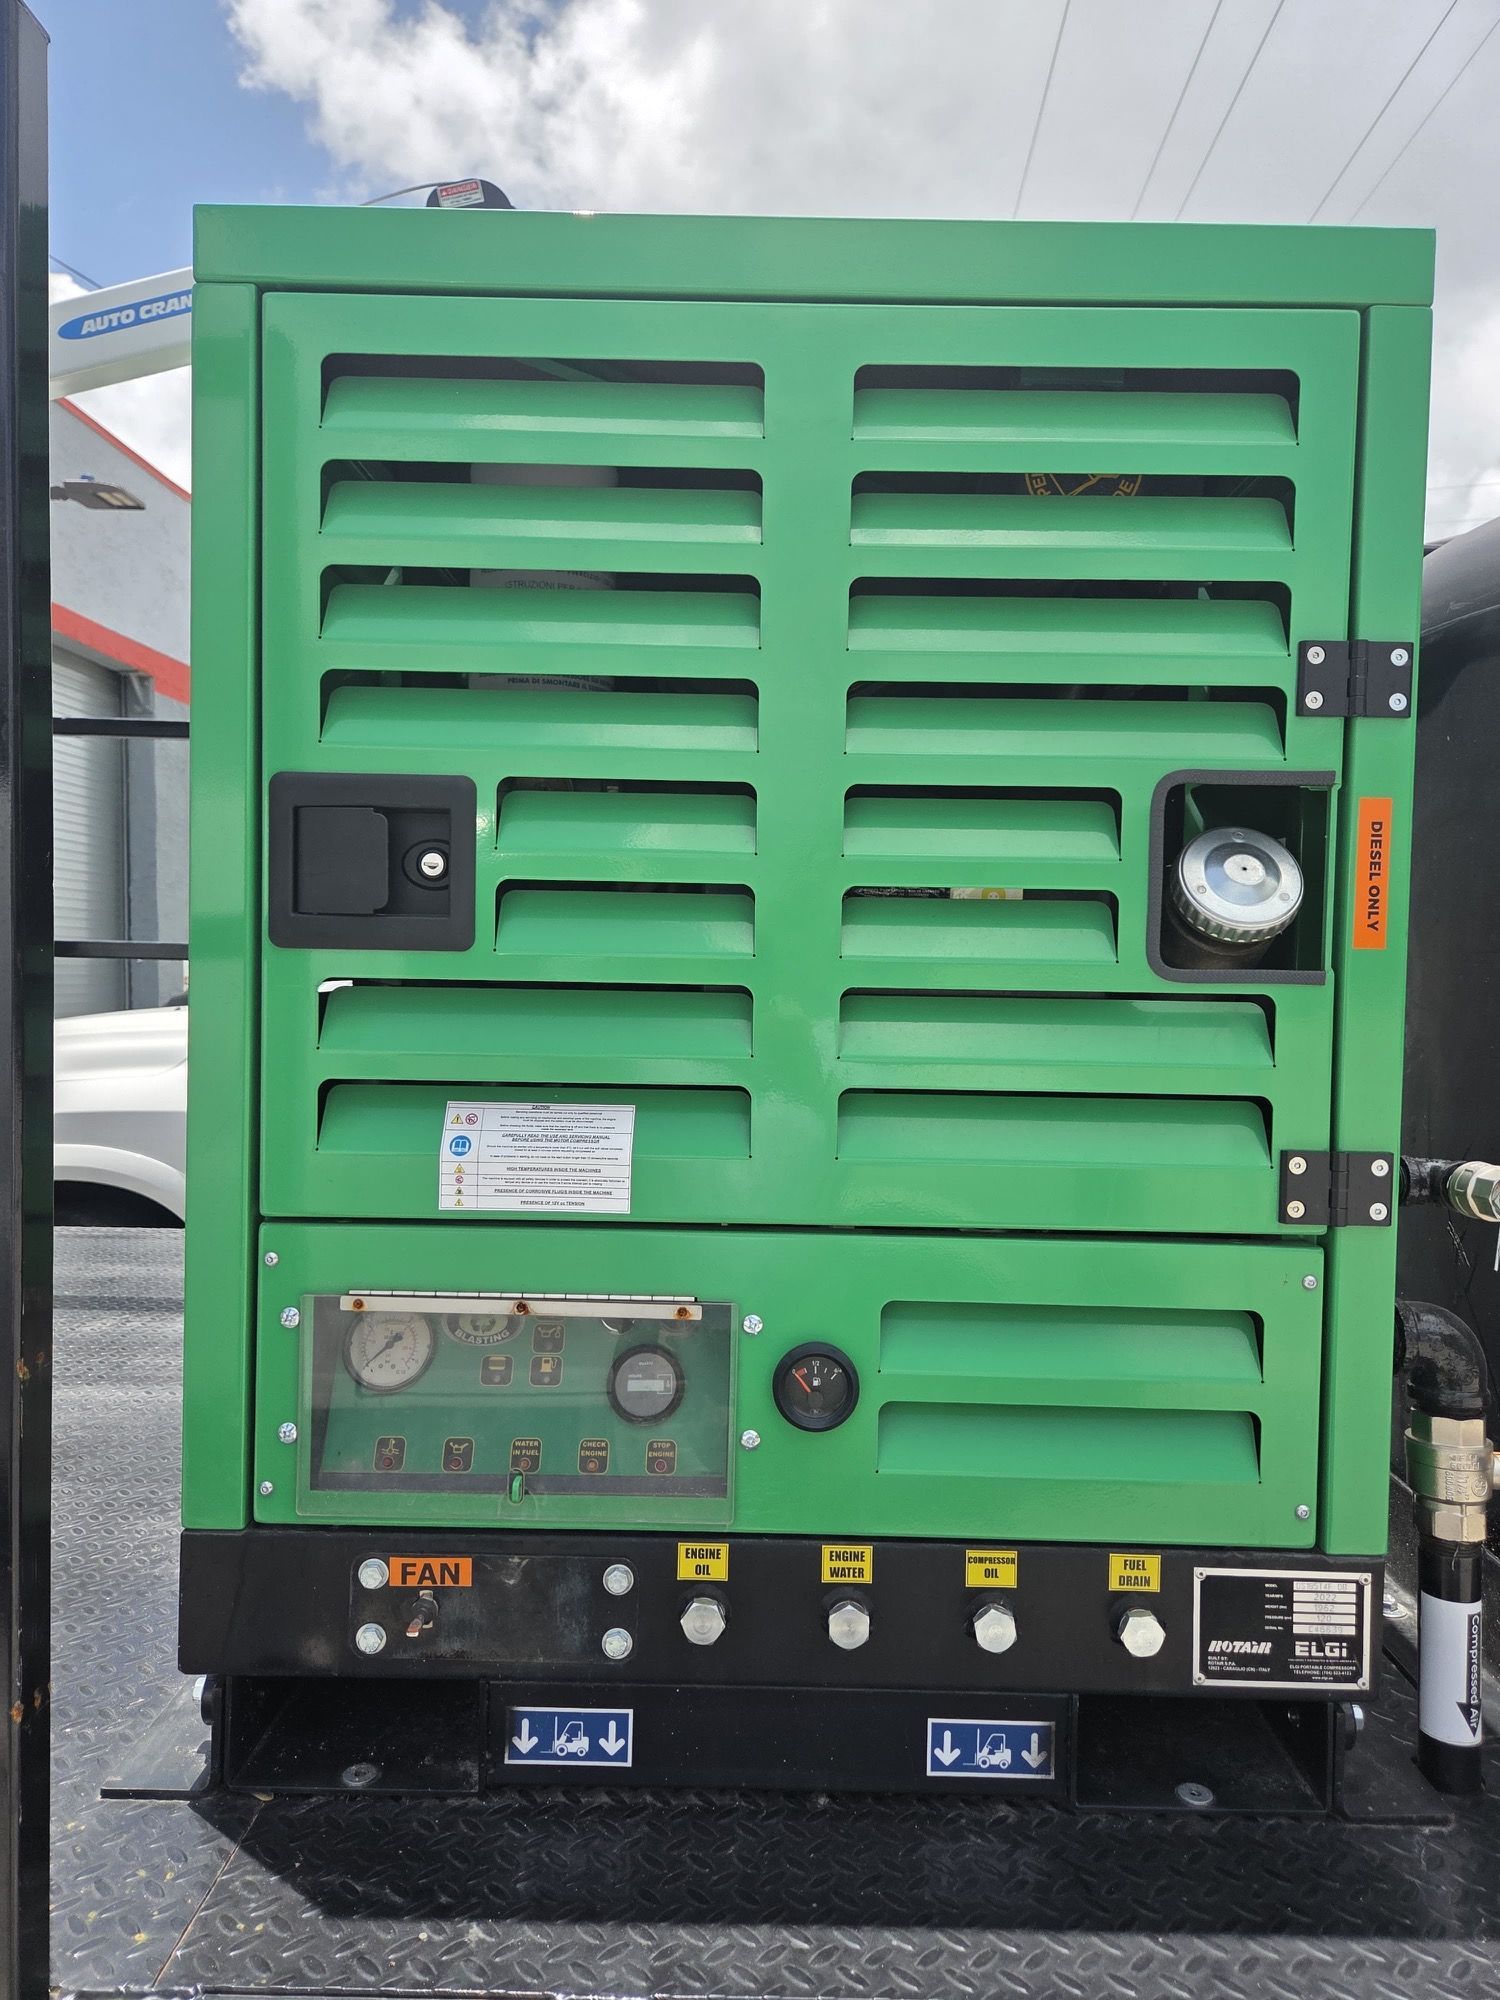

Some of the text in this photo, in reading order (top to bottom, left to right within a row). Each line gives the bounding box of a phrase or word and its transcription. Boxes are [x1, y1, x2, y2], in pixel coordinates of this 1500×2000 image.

[81, 309, 136, 335] AUTO
[1367, 821, 1383, 931] DIESEL ONLY
[454, 1328, 510, 1344] BLASTING
[685, 1548, 721, 1560] ENGINE
[829, 1550, 866, 1562] ENGINE
[968, 1556, 1016, 1565] COMPRESSOR
[1123, 1559, 1147, 1571] FUEL
[401, 1562, 460, 1585] FAN
[694, 1564, 711, 1576] OIL
[829, 1566, 865, 1579] WATER
[983, 1568, 1000, 1579] OIL
[1118, 1575, 1151, 1587] DRAIN
[1314, 1593, 1337, 1601] 2022
[1314, 1604, 1335, 1612] 1962
[1469, 1614, 1480, 1728] Compressed Air
